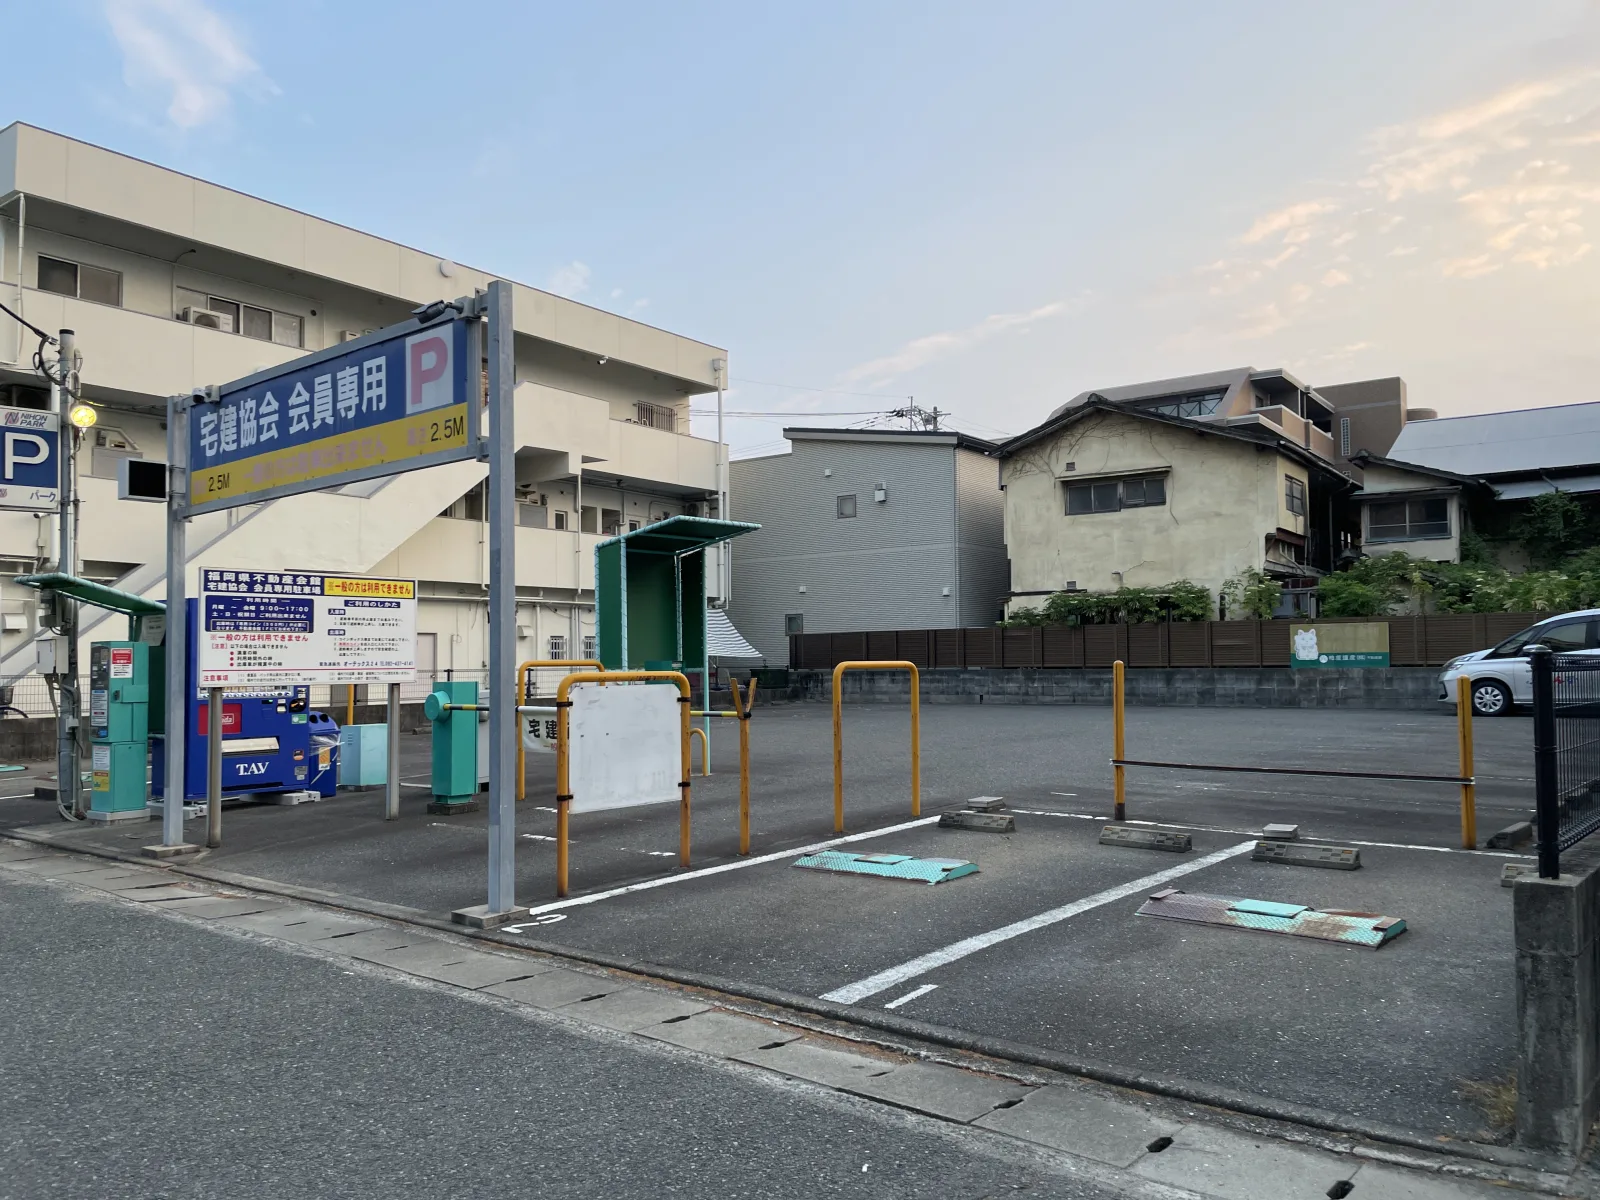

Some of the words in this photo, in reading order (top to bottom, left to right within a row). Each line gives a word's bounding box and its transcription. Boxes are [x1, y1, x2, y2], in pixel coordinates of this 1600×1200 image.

[410, 336, 449, 405] P
[199, 391, 280, 457] 宅建協会
[288, 355, 387, 435] 会員専用
[19, 420, 46, 428] PARK
[20, 412, 48, 422] NIHON
[430, 415, 464, 442] 2.5M
[4, 431, 50, 480] P
[208, 473, 231, 493] 2.5M
[29, 489, 57, 503] パーク
[207, 571, 322, 586] 福岡県不動産会館
[207, 581, 249, 592] 宅建協会
[253, 584, 322, 595] 会員専用駐車場
[347, 600, 398, 608] ご利用のしかた
[203, 674, 229, 682] 注意事項
